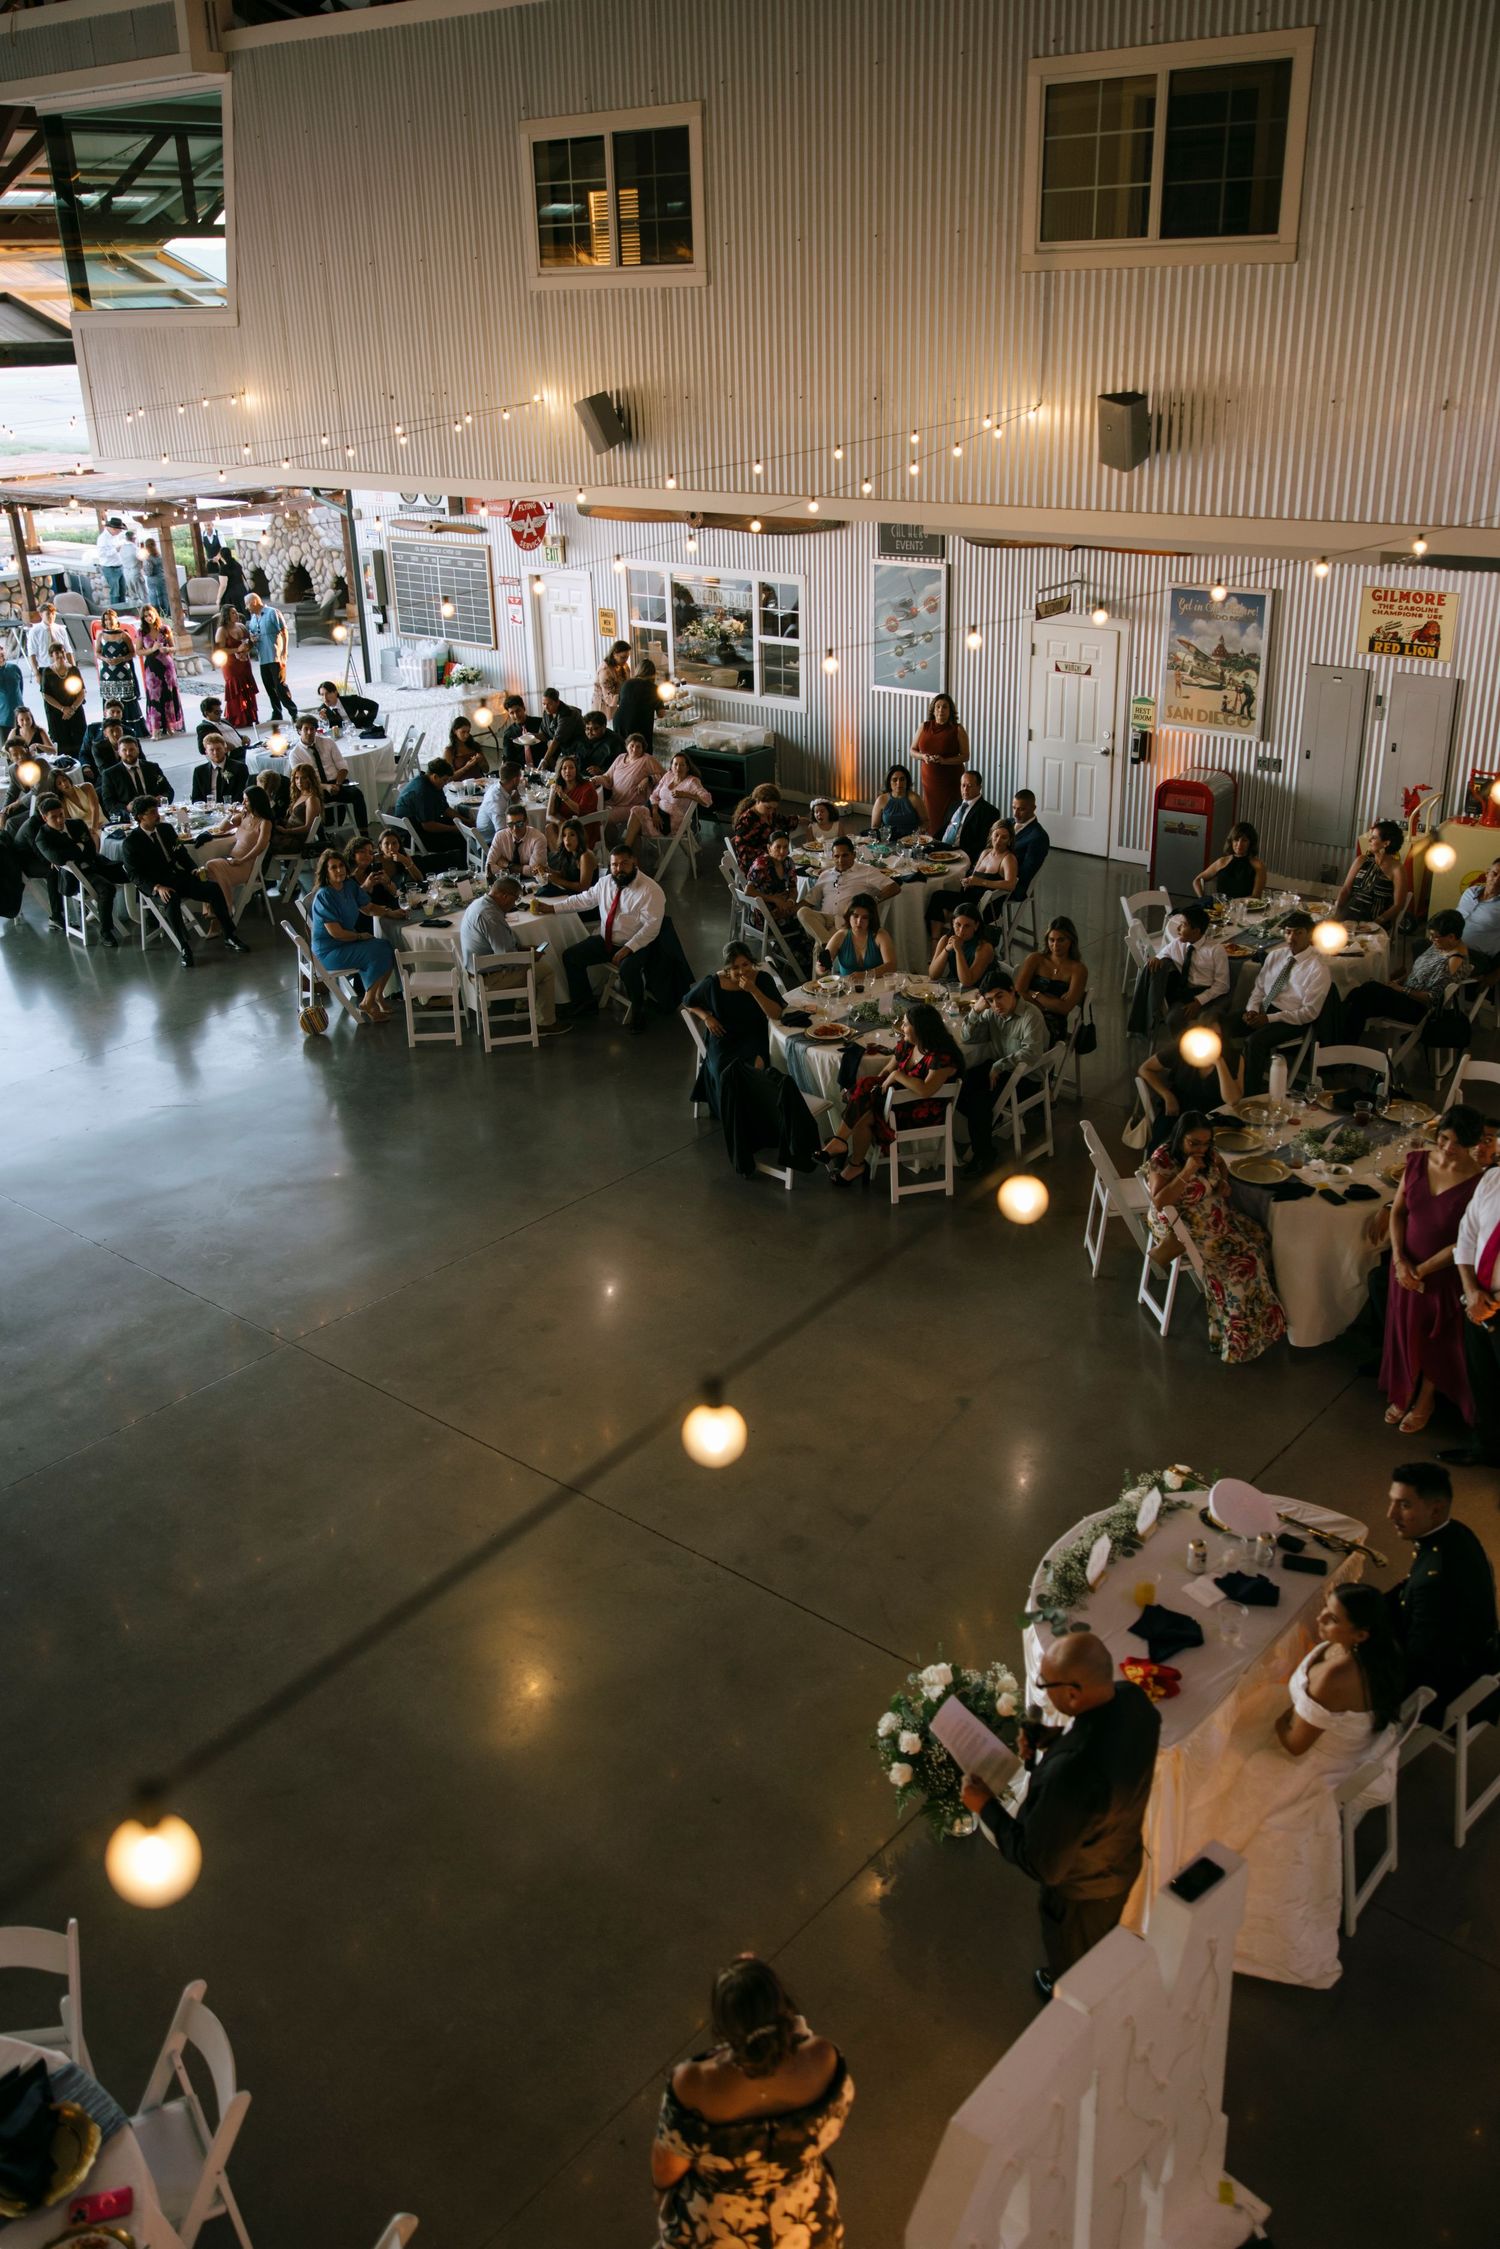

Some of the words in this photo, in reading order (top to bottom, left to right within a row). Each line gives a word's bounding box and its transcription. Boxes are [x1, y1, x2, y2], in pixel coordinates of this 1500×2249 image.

[518, 502, 537, 512] FLYING
[523, 513, 537, 539] A
[519, 536, 542, 550] SERVICE
[895, 540, 924, 551] EVENTS
[545, 547, 560, 562] EXIT
[1371, 589, 1447, 607] GILMORE
[1194, 600, 1203, 612] in
[1397, 605, 1439, 614] GASOLINE
[1372, 609, 1423, 619] CHAMPIONS
[1373, 641, 1400, 654] RED
[1404, 644, 1436, 657] LION
[1135, 707, 1151, 715] REST
[1166, 705, 1194, 721] SAN
[1197, 708, 1252, 728] DIEGO
[1133, 713, 1152, 722] ROOM
